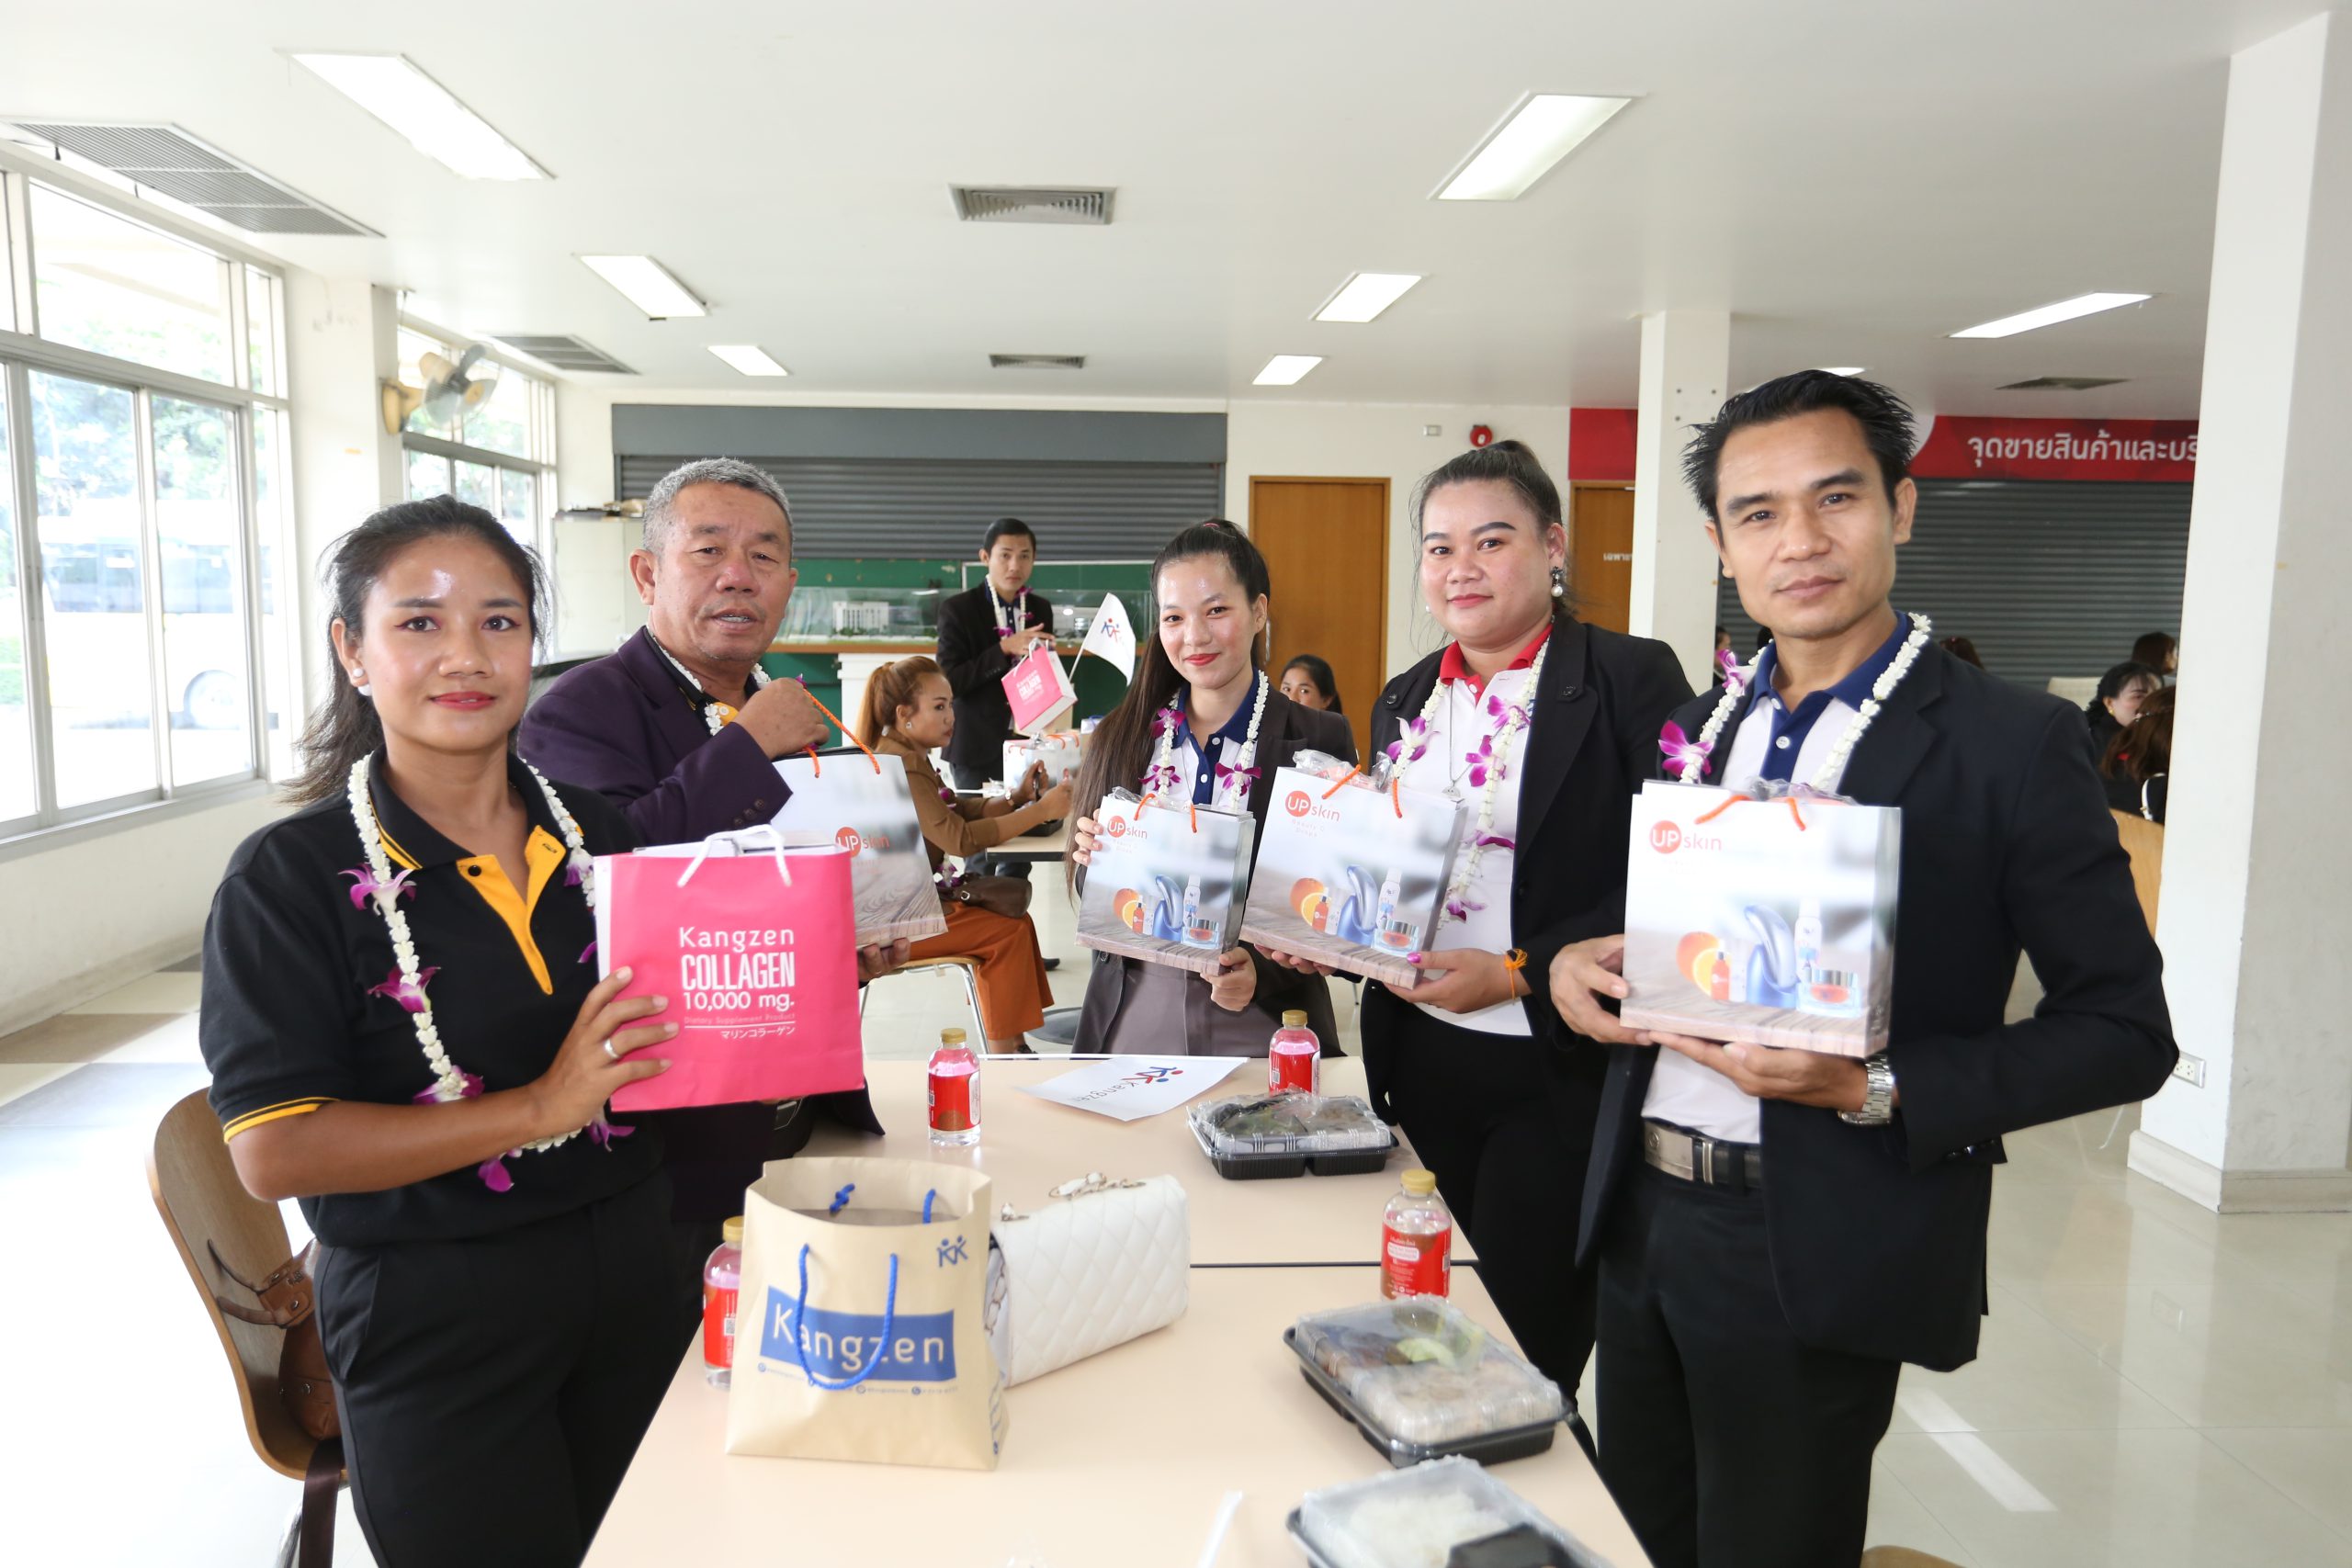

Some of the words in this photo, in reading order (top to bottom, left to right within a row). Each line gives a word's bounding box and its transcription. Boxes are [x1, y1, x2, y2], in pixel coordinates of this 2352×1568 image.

[679, 927, 795, 953] Kangzen
[681, 952, 796, 991] COLLAGEN
[683, 992, 752, 1012] 10,000
[758, 992, 796, 1012] mg.
[720, 1026, 796, 1040] マリンコラーゲン
